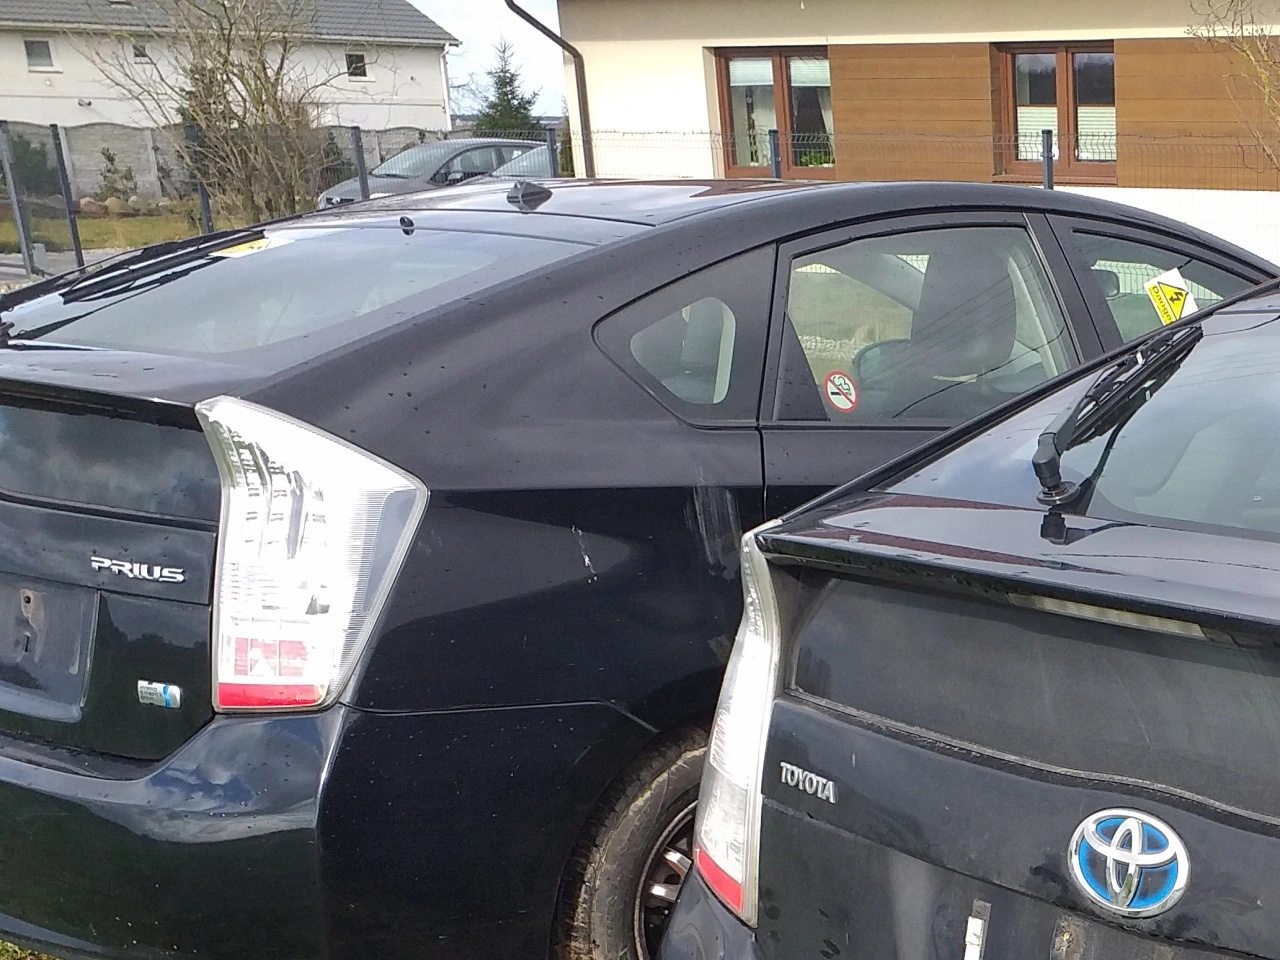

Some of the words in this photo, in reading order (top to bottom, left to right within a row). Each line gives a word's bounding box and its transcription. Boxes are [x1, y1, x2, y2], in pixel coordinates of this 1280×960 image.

[1152, 285, 1172, 321] Dange
[90, 556, 185, 582] PRIUS
[780, 761, 836, 804] TOYOTA
